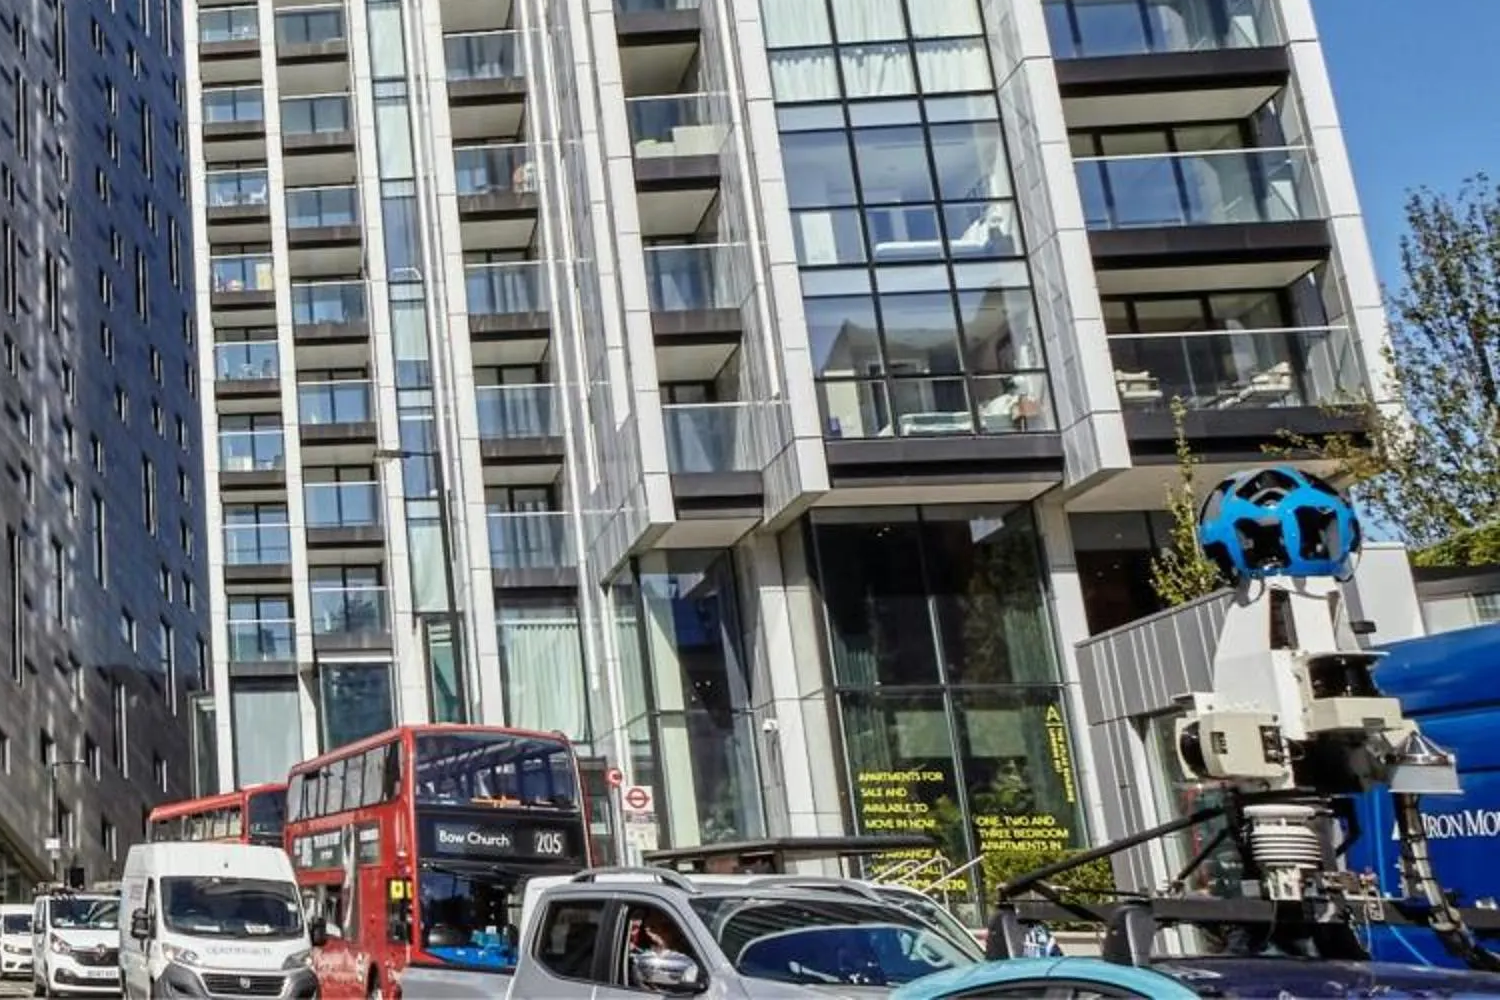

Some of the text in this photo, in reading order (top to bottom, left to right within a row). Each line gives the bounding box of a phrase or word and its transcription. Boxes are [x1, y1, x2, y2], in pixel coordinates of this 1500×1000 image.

[858, 771, 944, 781] APARTMENTS FOR
[860, 787, 908, 797] SALE AND
[862, 803, 929, 813] AVAILABLE TO
[864, 819, 895, 829] MOVE
[896, 819, 908, 829] IN
[1003, 815, 1030, 826] TWO
[1031, 815, 1056, 826] AND
[1420, 808, 1500, 839] IRON MO
[439, 829, 510, 847] Bow Church
[979, 827, 1069, 839] THREE BEDROOM
[534, 831, 562, 854] 205
[980, 840, 1062, 851] APARTMENTS IN
